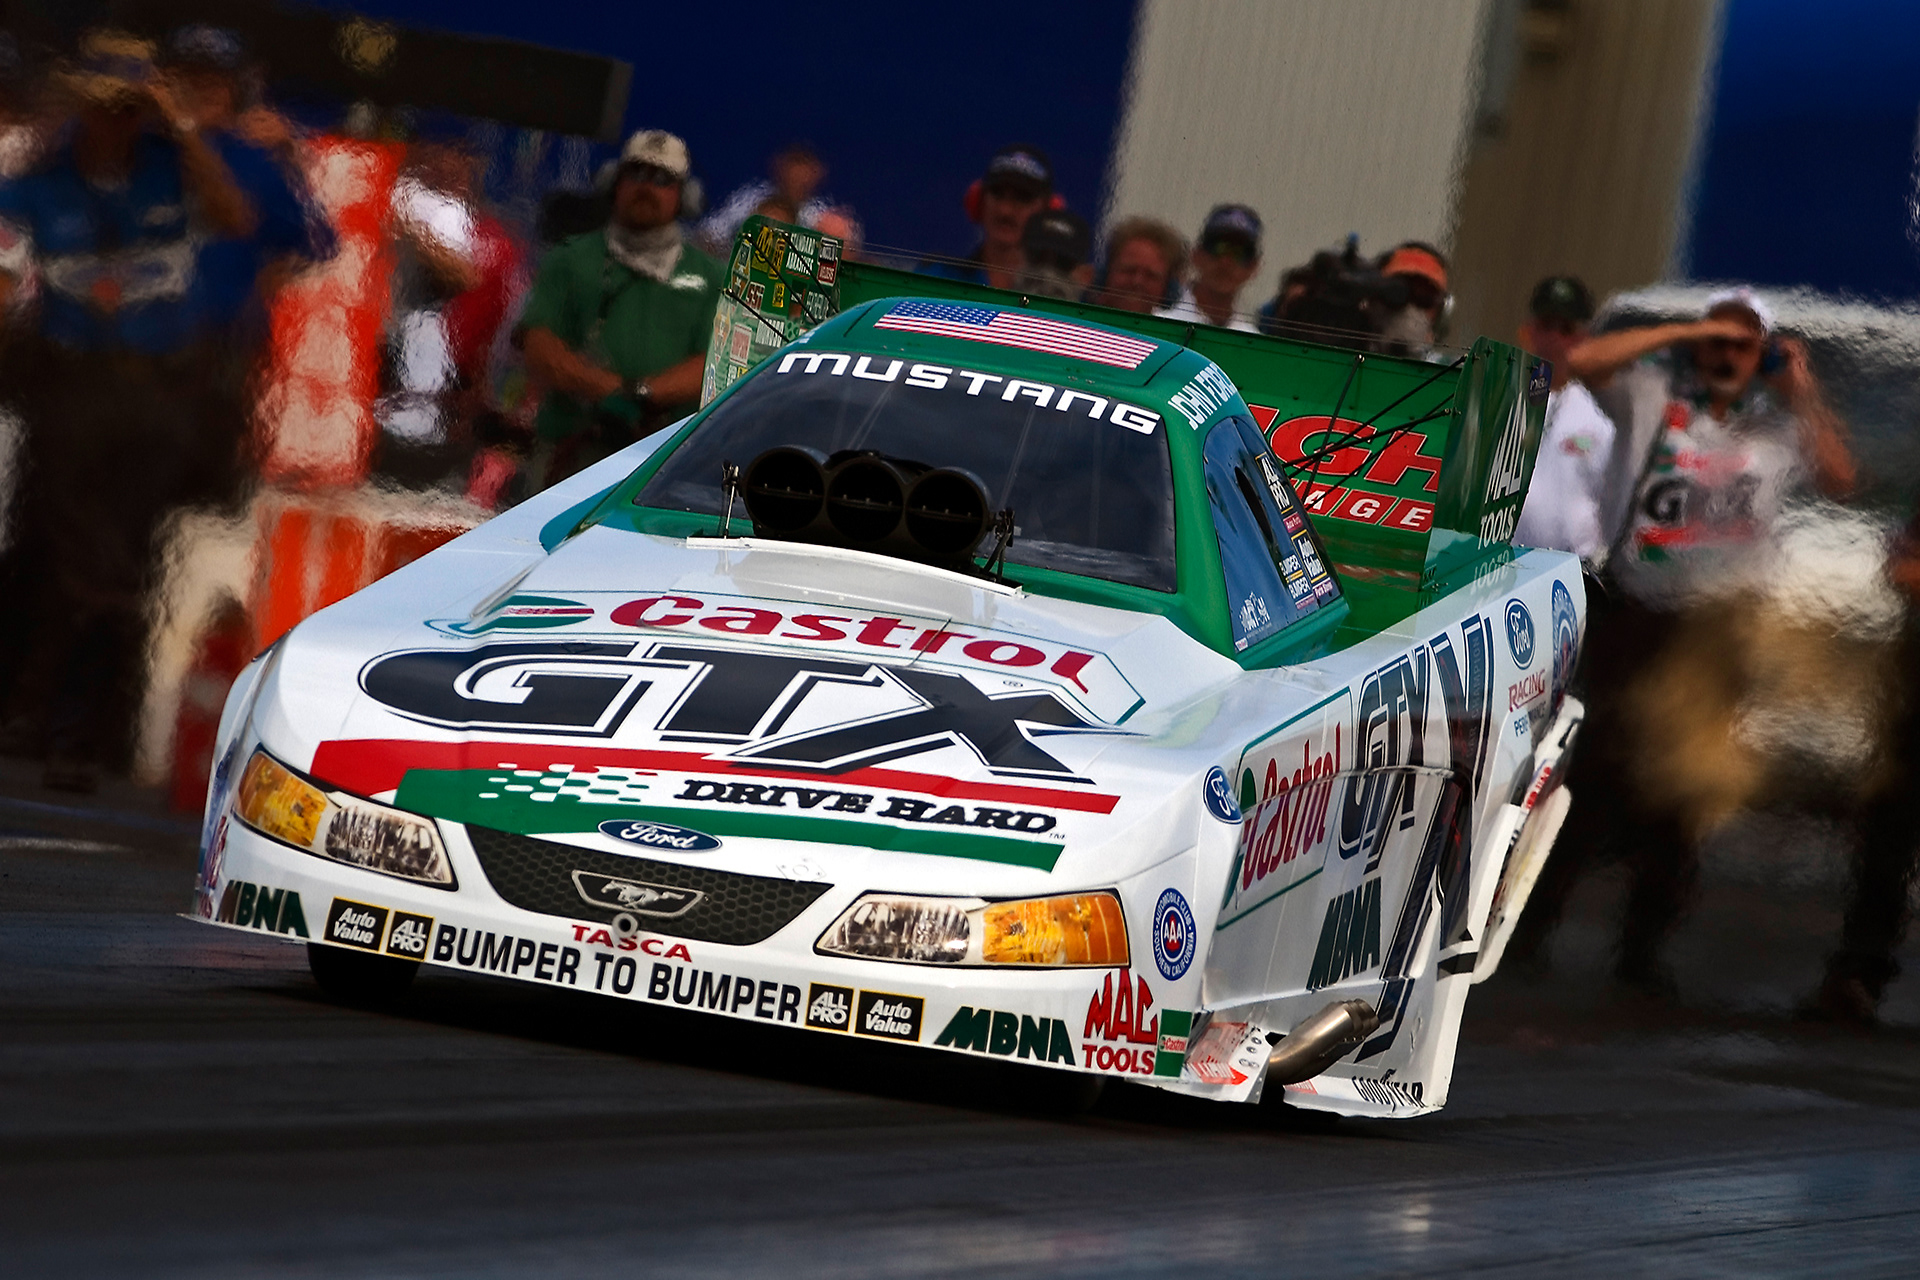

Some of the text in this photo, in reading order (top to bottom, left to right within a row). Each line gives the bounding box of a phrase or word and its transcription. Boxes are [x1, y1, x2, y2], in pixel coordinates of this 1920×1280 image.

[777, 352, 1162, 435] MUSTANG
[1167, 362, 1238, 430] JOHN FORC
[1477, 503, 1516, 549] TOOLS
[1298, 537, 1315, 559] Auto
[1304, 556, 1323, 578] Value
[1288, 577, 1311, 599] BUMPER
[610, 596, 1095, 694] Castrol
[1510, 611, 1531, 655] Ford
[1508, 669, 1546, 712] RACING
[358, 640, 1145, 786] GTX
[674, 779, 874, 814] DRIVE
[877, 795, 1057, 834] HARD
[1241, 722, 1341, 891] Castrol
[620, 822, 699, 849] Ford
[214, 879, 310, 938] MBNA
[338, 908, 377, 929] Auto
[1155, 892, 1192, 926] AUTOMOBILE CLUB
[333, 921, 375, 945] Value
[390, 934, 426, 953] PRO
[393, 919, 426, 939] ALL
[571, 924, 694, 962] TASCA
[1163, 920, 1183, 943] AAA
[1307, 878, 1381, 993] MBNA
[1153, 929, 1194, 977] SOUTHERN CALIFORNIA
[432, 923, 802, 1023] BUMPER TO BUMPER
[808, 1007, 848, 1025] PRO
[812, 991, 849, 1010] ALL
[869, 998, 913, 1019] Auto
[1083, 969, 1158, 1045] MAC
[864, 1013, 913, 1036] Value
[934, 1006, 1076, 1066] MBNA
[1082, 1043, 1156, 1075] TOOLS
[1164, 1037, 1188, 1052] Castrol
[1351, 1070, 1426, 1112] GOODYEAR
